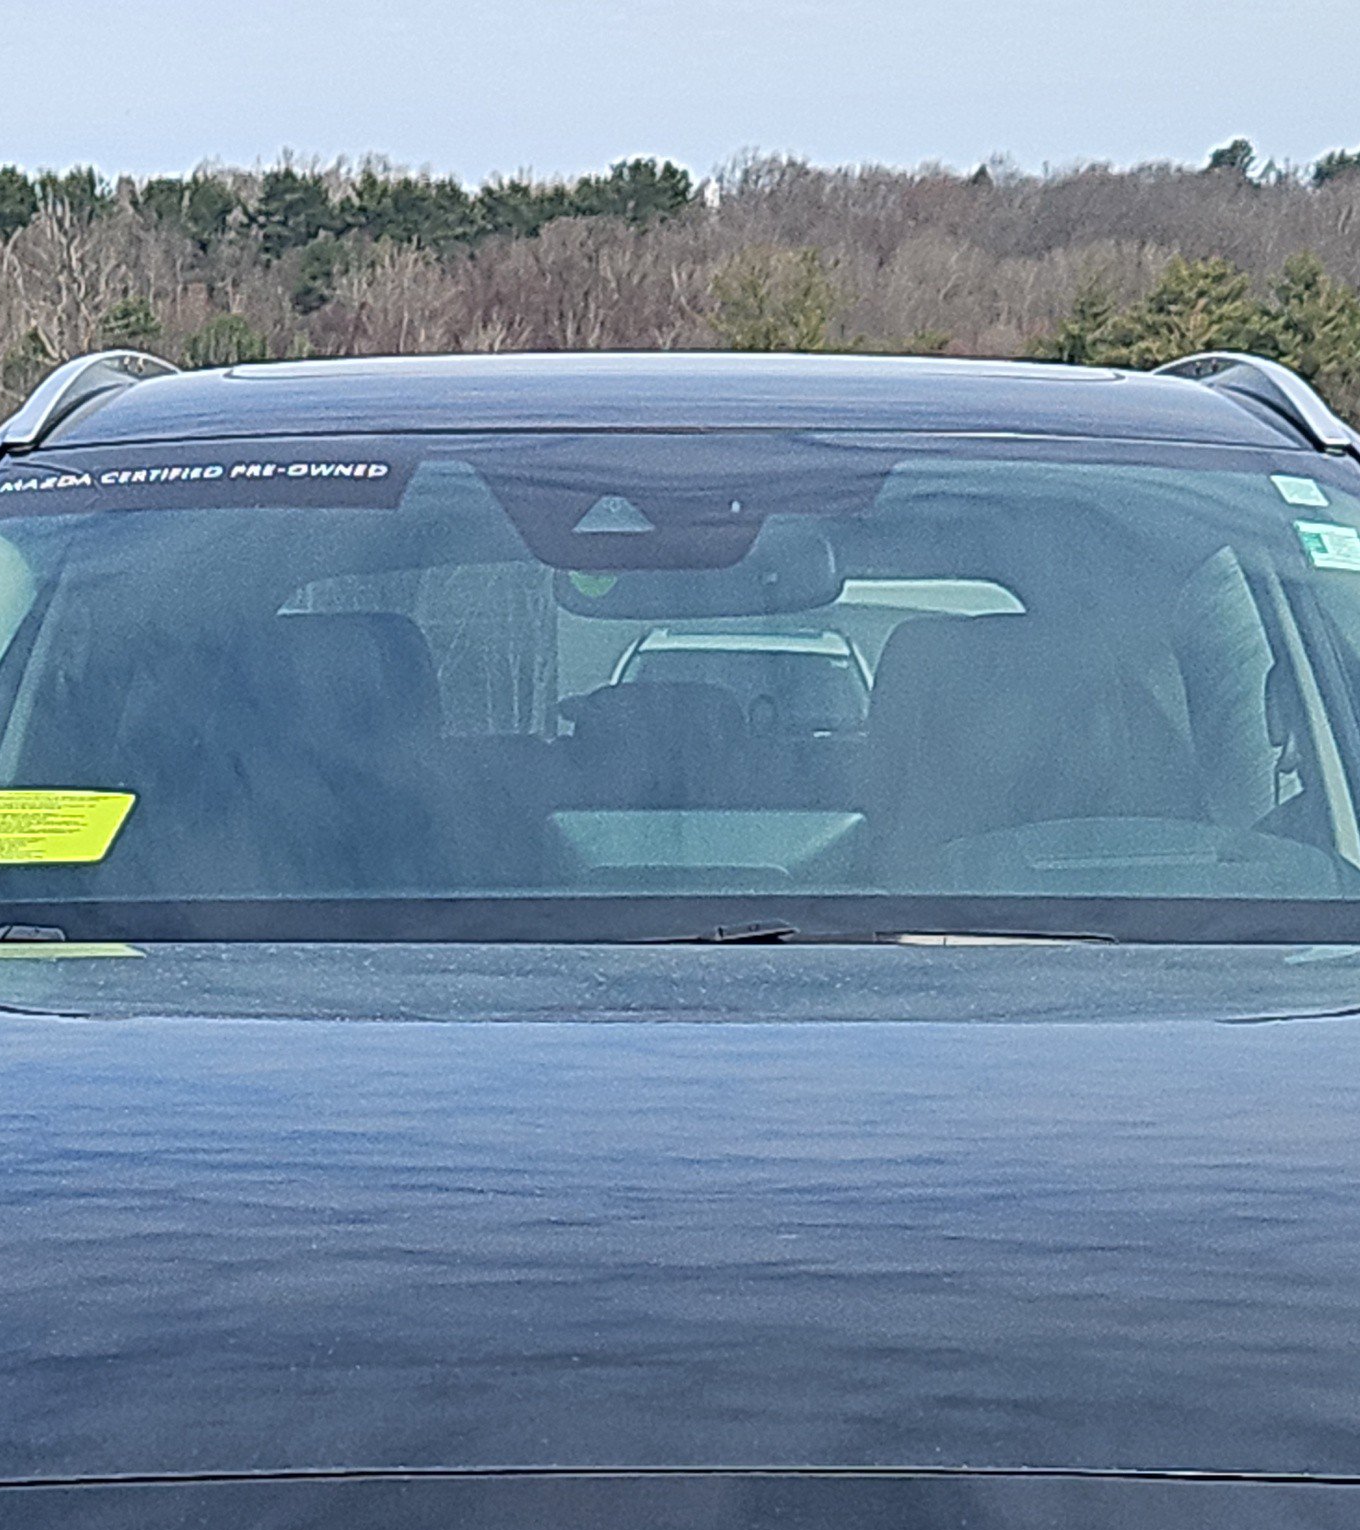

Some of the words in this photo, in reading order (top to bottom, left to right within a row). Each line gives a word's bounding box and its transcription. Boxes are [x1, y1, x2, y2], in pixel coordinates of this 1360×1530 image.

[0, 472, 92, 492] MAZDA
[100, 465, 224, 485] CERTIFIED
[229, 462, 389, 479] PRE-OWNED
